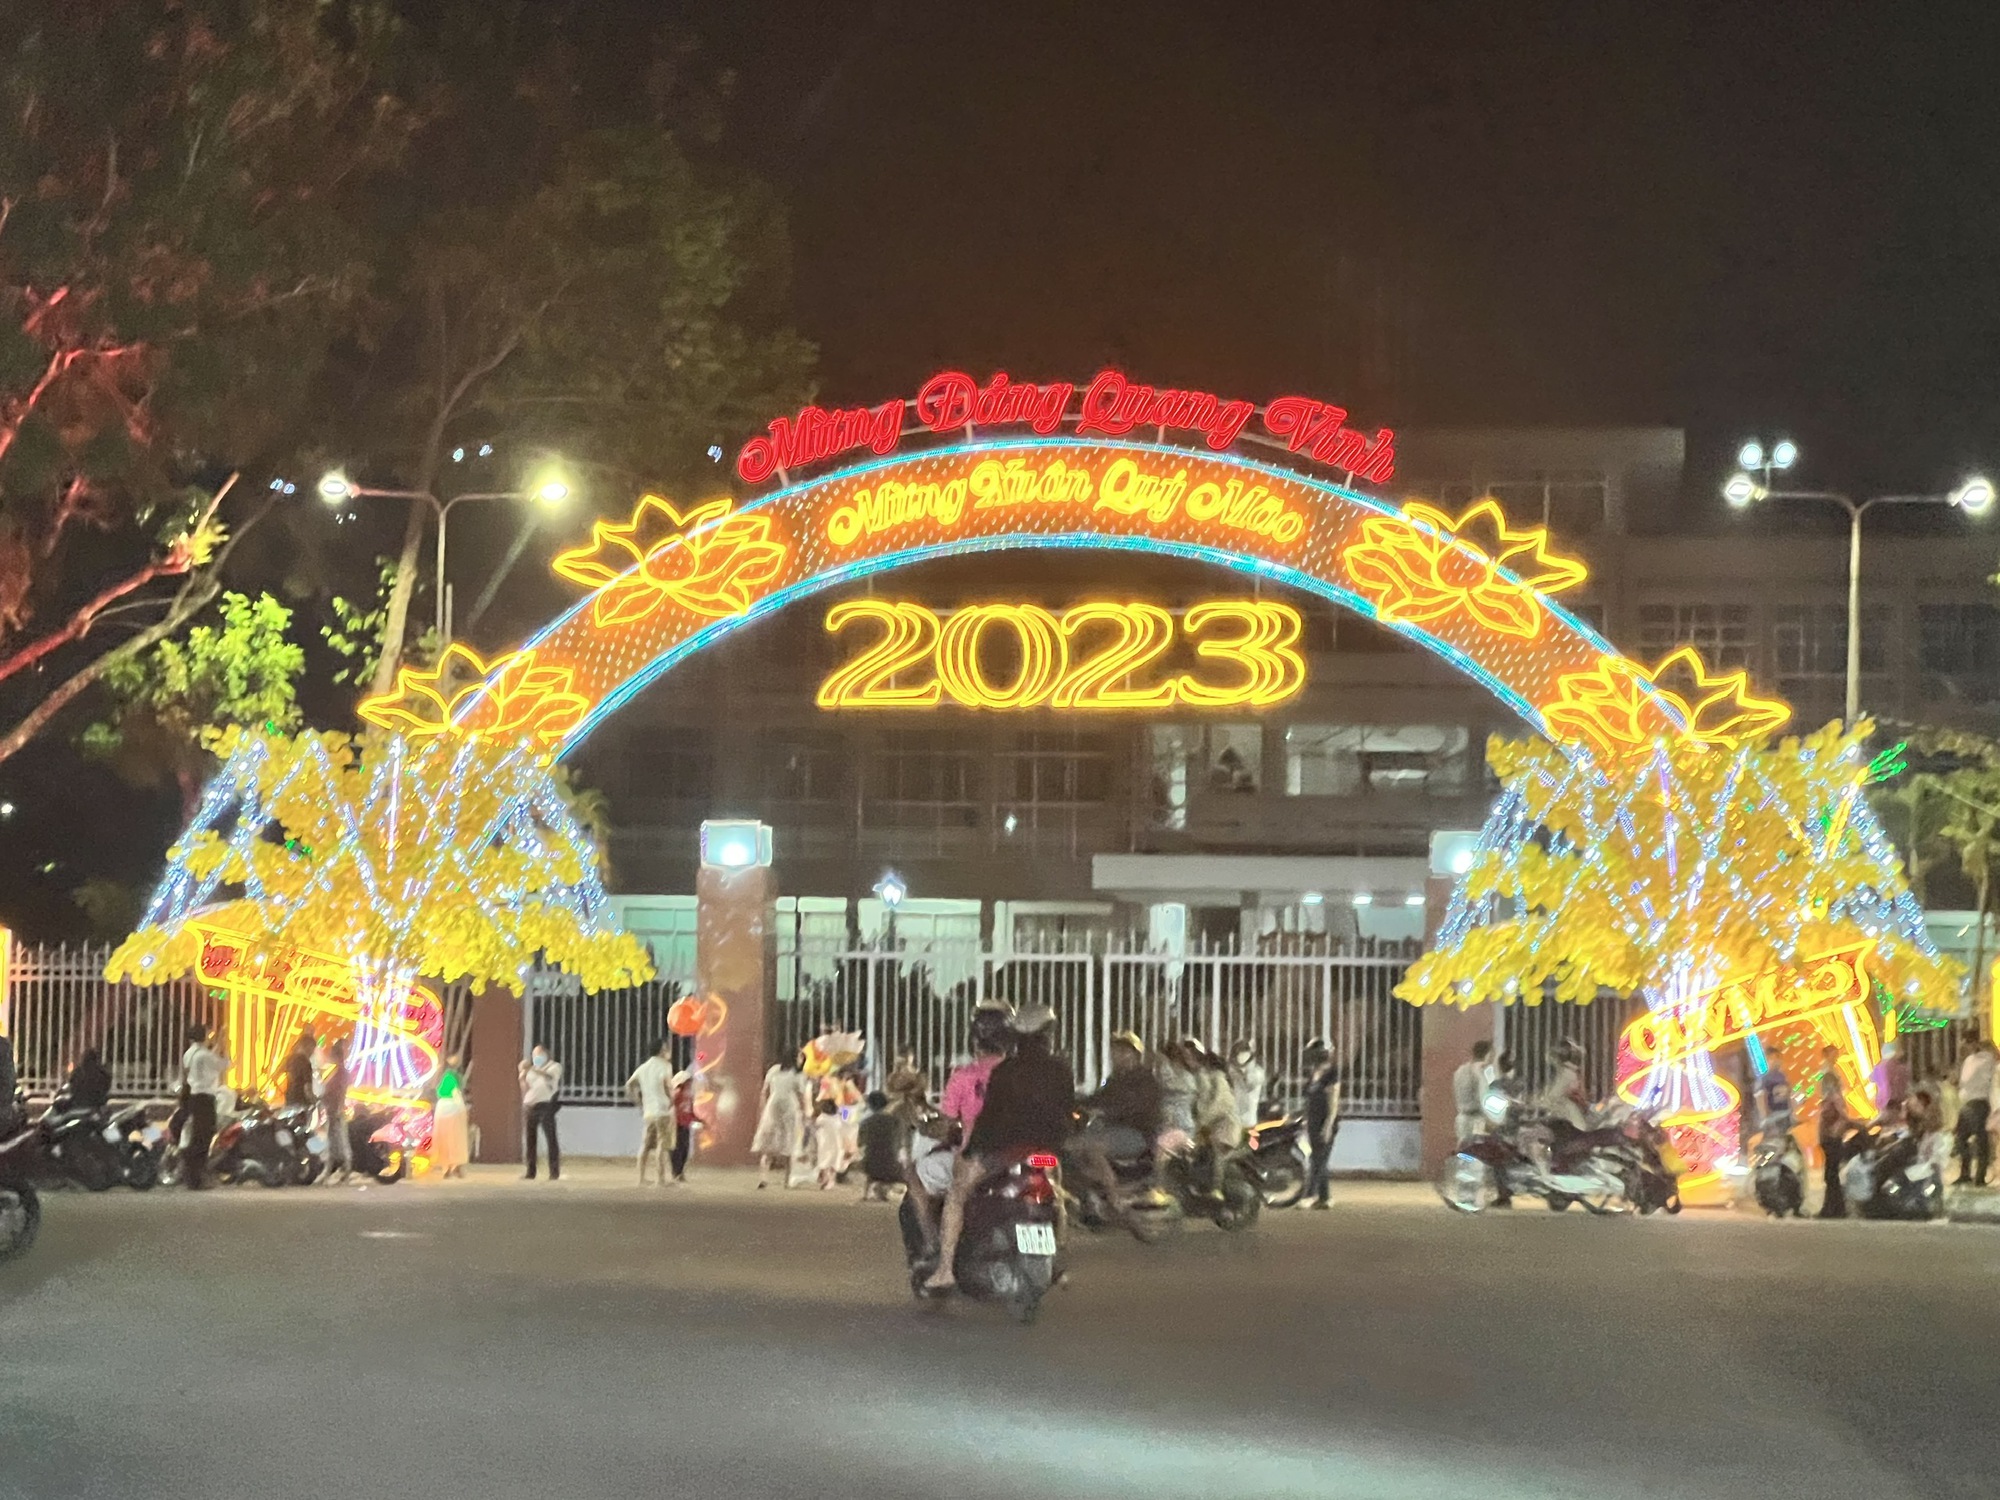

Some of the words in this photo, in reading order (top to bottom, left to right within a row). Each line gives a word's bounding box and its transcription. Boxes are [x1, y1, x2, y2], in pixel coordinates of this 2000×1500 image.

[737, 398, 906, 484] Mừng
[1075, 370, 1256, 451] Quang
[1263, 396, 1395, 485] Vinh
[968, 458, 1094, 509] Xuân
[1092, 457, 1187, 524] Quý
[1185, 478, 1304, 543] Mão
[817, 600, 1306, 708] 2023
